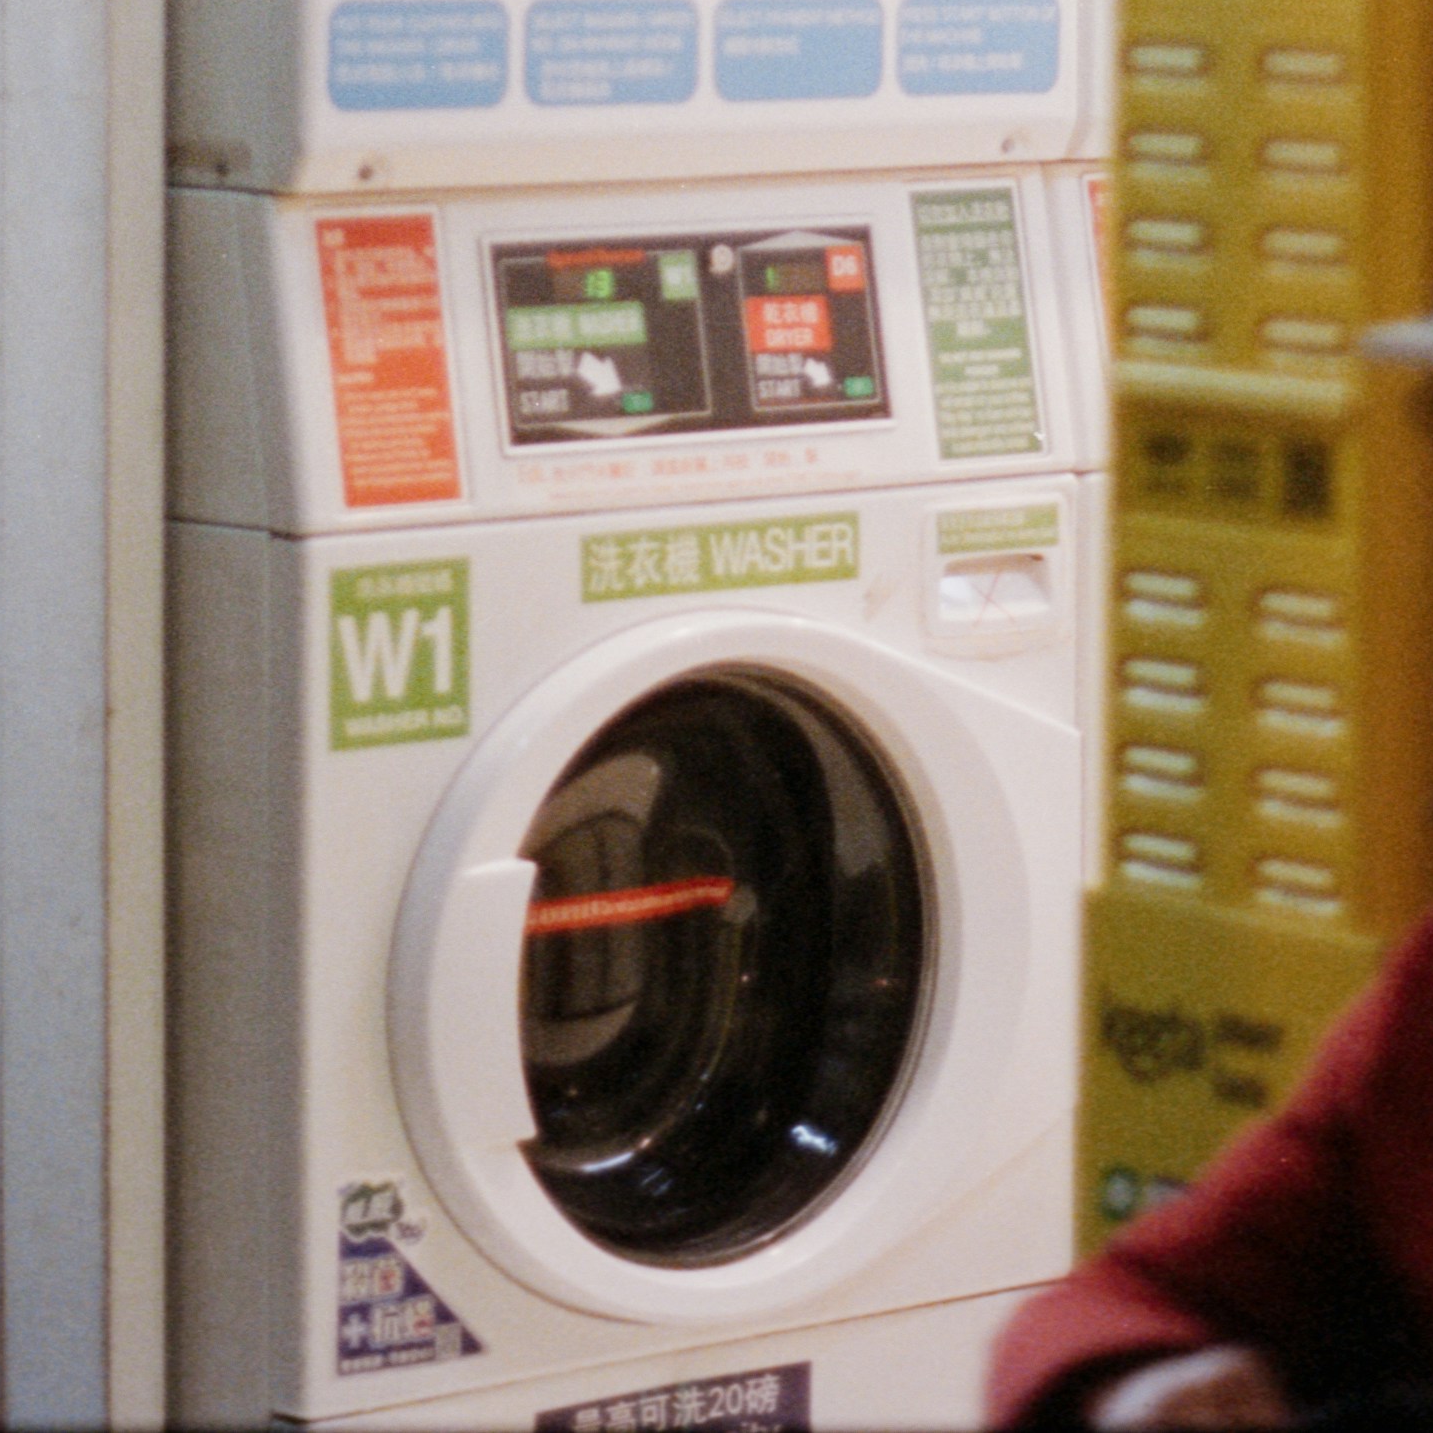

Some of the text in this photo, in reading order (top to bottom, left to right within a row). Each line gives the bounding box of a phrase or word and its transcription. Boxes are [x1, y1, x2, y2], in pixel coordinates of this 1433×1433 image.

[831, 254, 860, 278] D6
[766, 326, 815, 348] DRYER
[589, 522, 857, 593] 洗衣機 WASHER
[337, 603, 453, 704] W1
[573, 1373, 780, 1433] 最高可洗20磅
